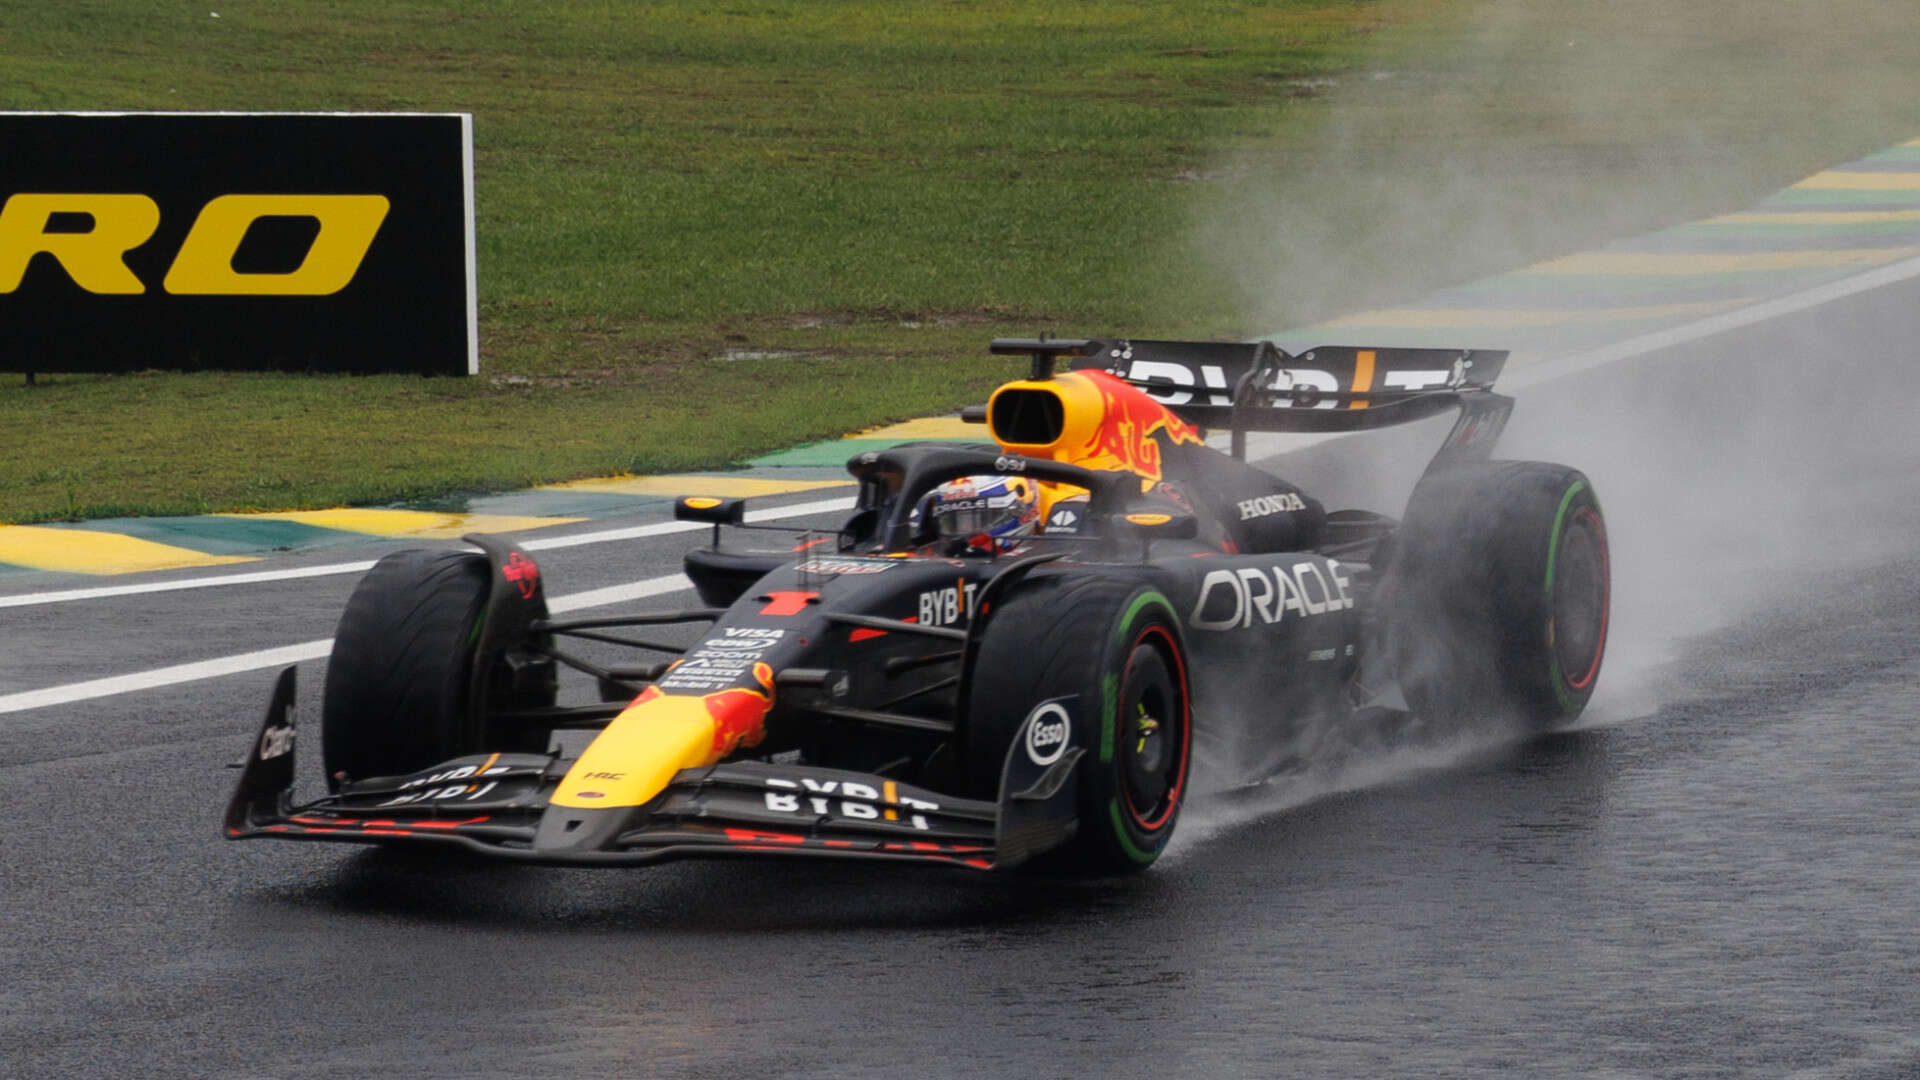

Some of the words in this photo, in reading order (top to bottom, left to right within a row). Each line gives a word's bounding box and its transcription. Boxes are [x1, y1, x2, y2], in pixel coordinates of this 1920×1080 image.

[1237, 492, 1306, 520] HONDA
[919, 577, 978, 626] BYBIT
[1189, 558, 1354, 631] ORACLE
[724, 627, 785, 638] VISA
[1033, 721, 1065, 747] Esso
[764, 778, 940, 831] BYBIT
